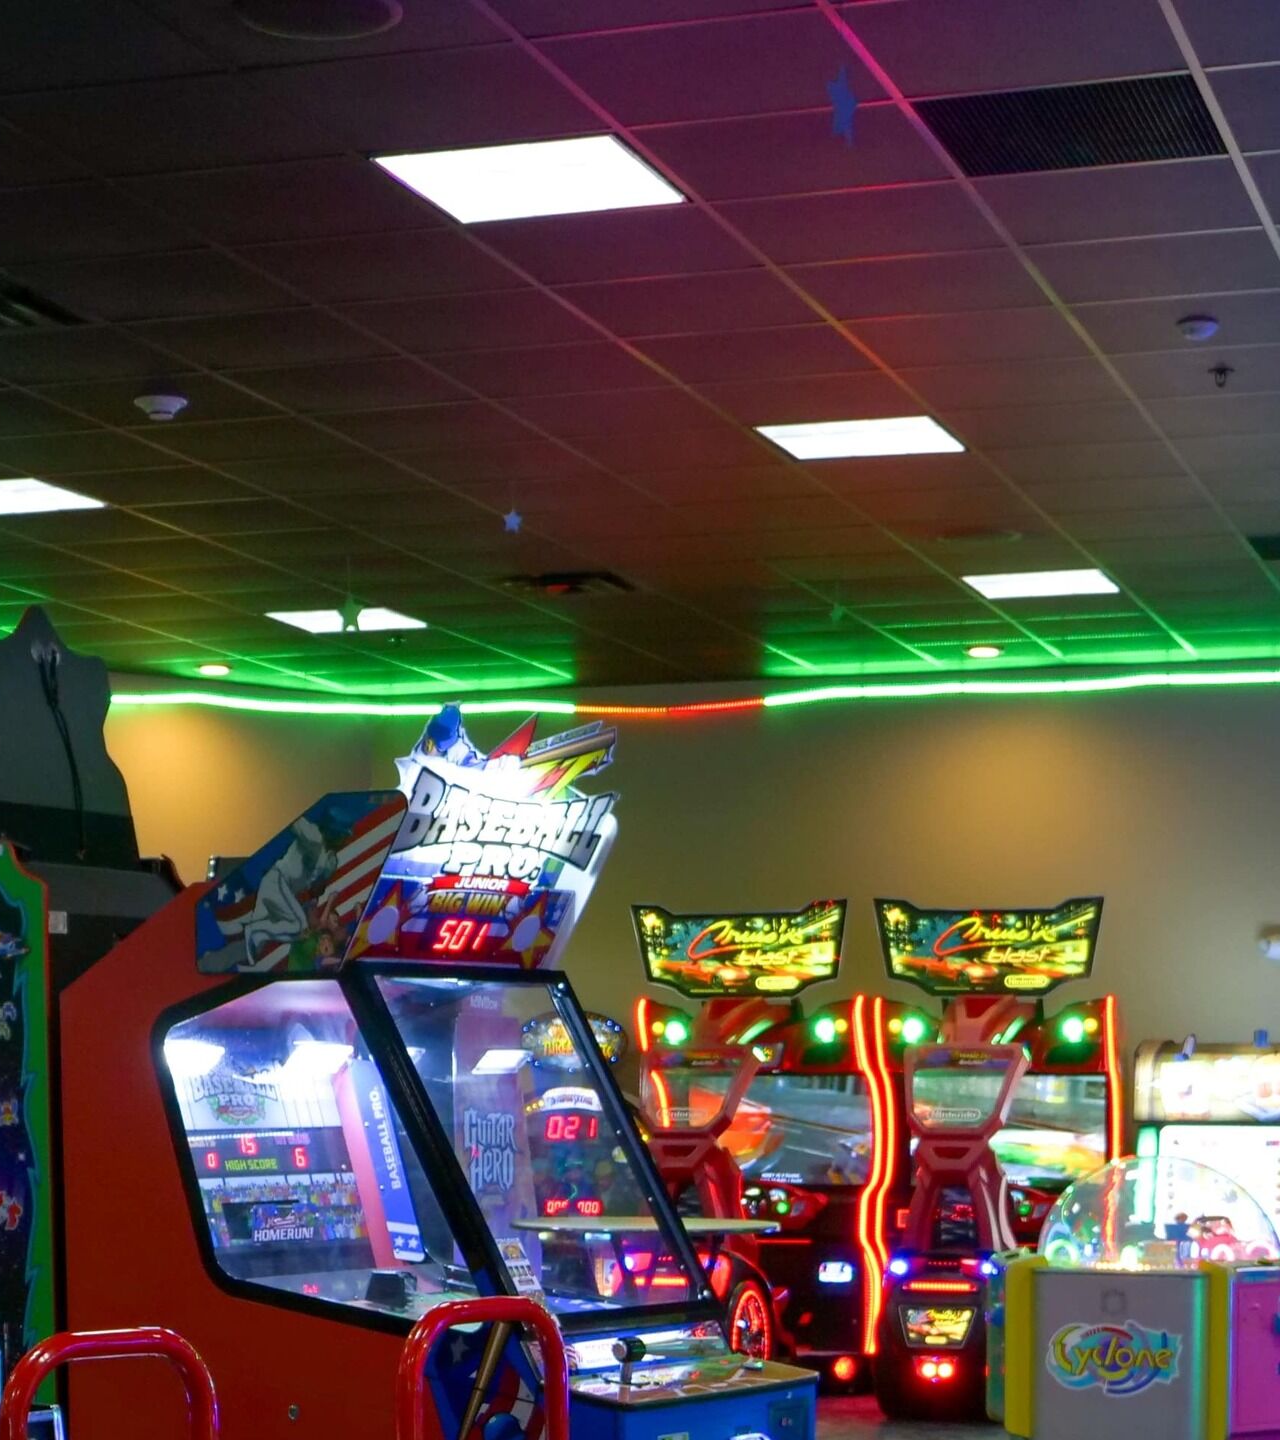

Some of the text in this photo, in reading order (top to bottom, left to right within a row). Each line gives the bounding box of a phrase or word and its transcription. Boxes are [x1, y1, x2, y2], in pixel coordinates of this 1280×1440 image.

[389, 766, 618, 872] BASEBALL
[455, 879, 509, 891] JUNIOR
[429, 892, 506, 913] BIG WIN
[433, 919, 491, 951] 501
[225, 1158, 279, 1171] HIGH SCORE
[295, 1148, 306, 1168] 6
[379, 1121, 402, 1190] BASEBALL
[254, 1226, 314, 1243] HOMERUN!
[1053, 1325, 1174, 1378] Cyclone
